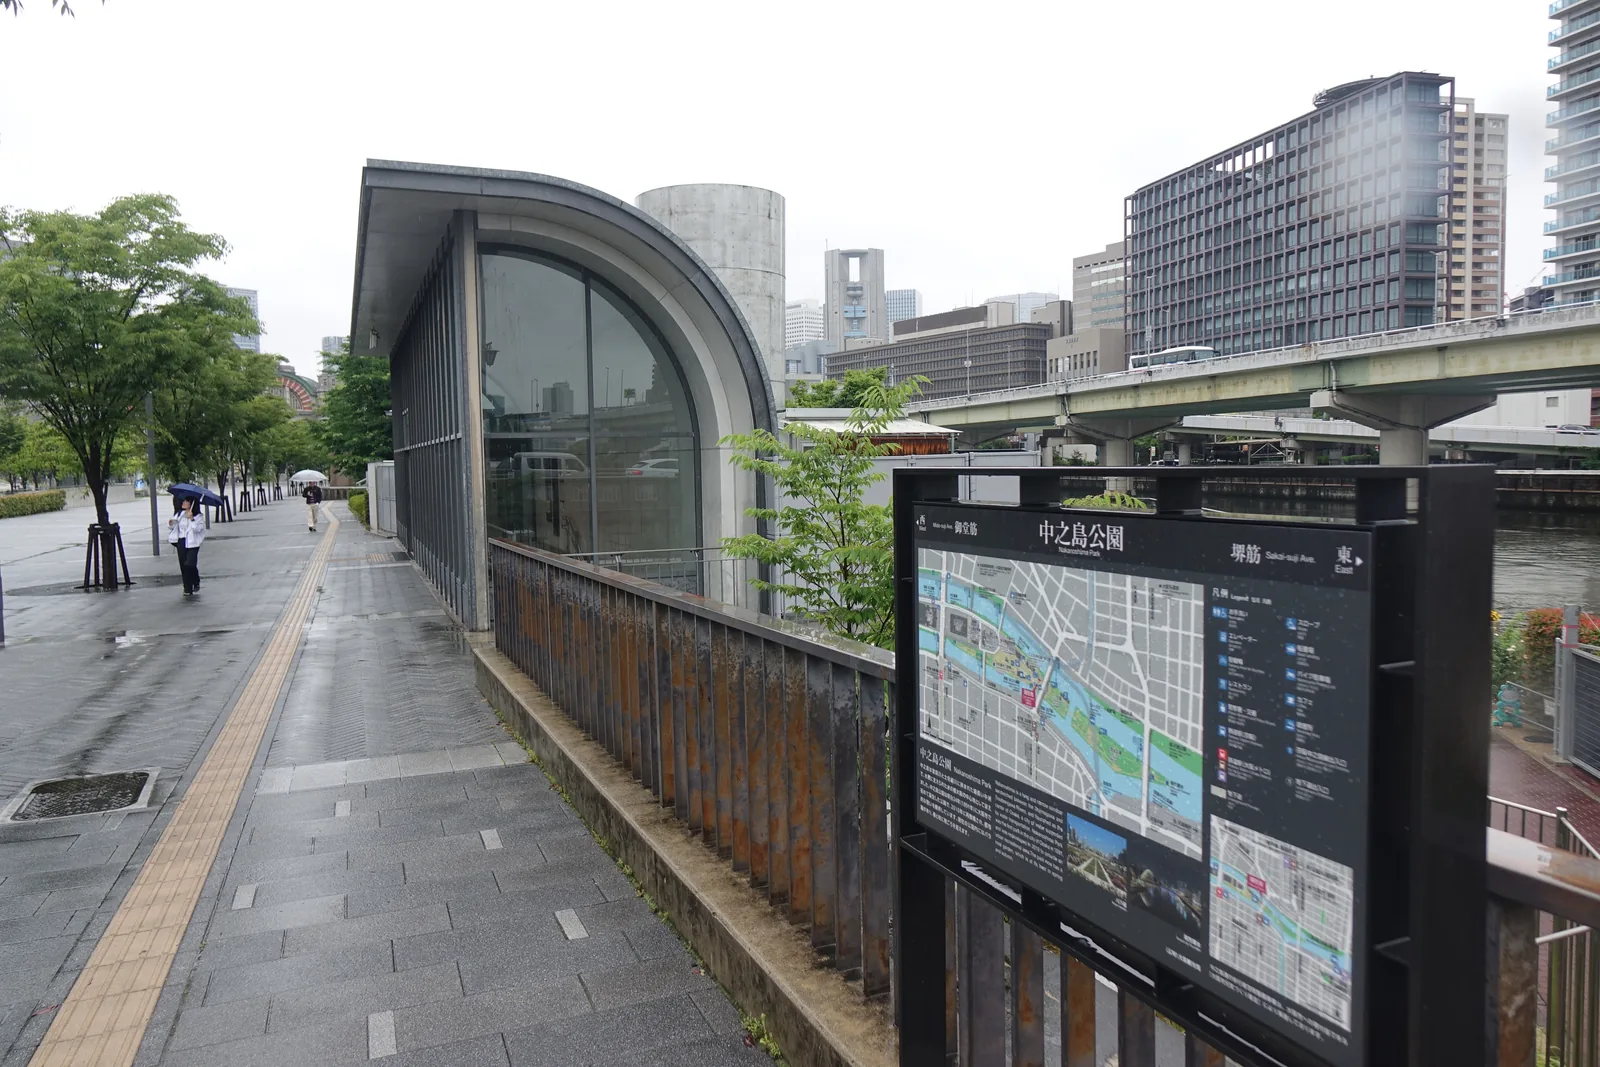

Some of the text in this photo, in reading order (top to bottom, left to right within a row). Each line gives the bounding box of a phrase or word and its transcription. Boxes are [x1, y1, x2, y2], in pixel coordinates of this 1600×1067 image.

[954, 520, 978, 536] 御堂筋
[1039, 520, 1124, 552] 中之島公園
[1058, 546, 1088, 556] Nakanoshima
[1230, 542, 1261, 564] 堺筋
[1265, 551, 1316, 564] Sakai-suji Ave.
[1336, 546, 1352, 564] 東
[1334, 564, 1354, 574] East
[920, 746, 952, 772] 中之島公園
[953, 766, 992, 790] Nakanoshima Park
